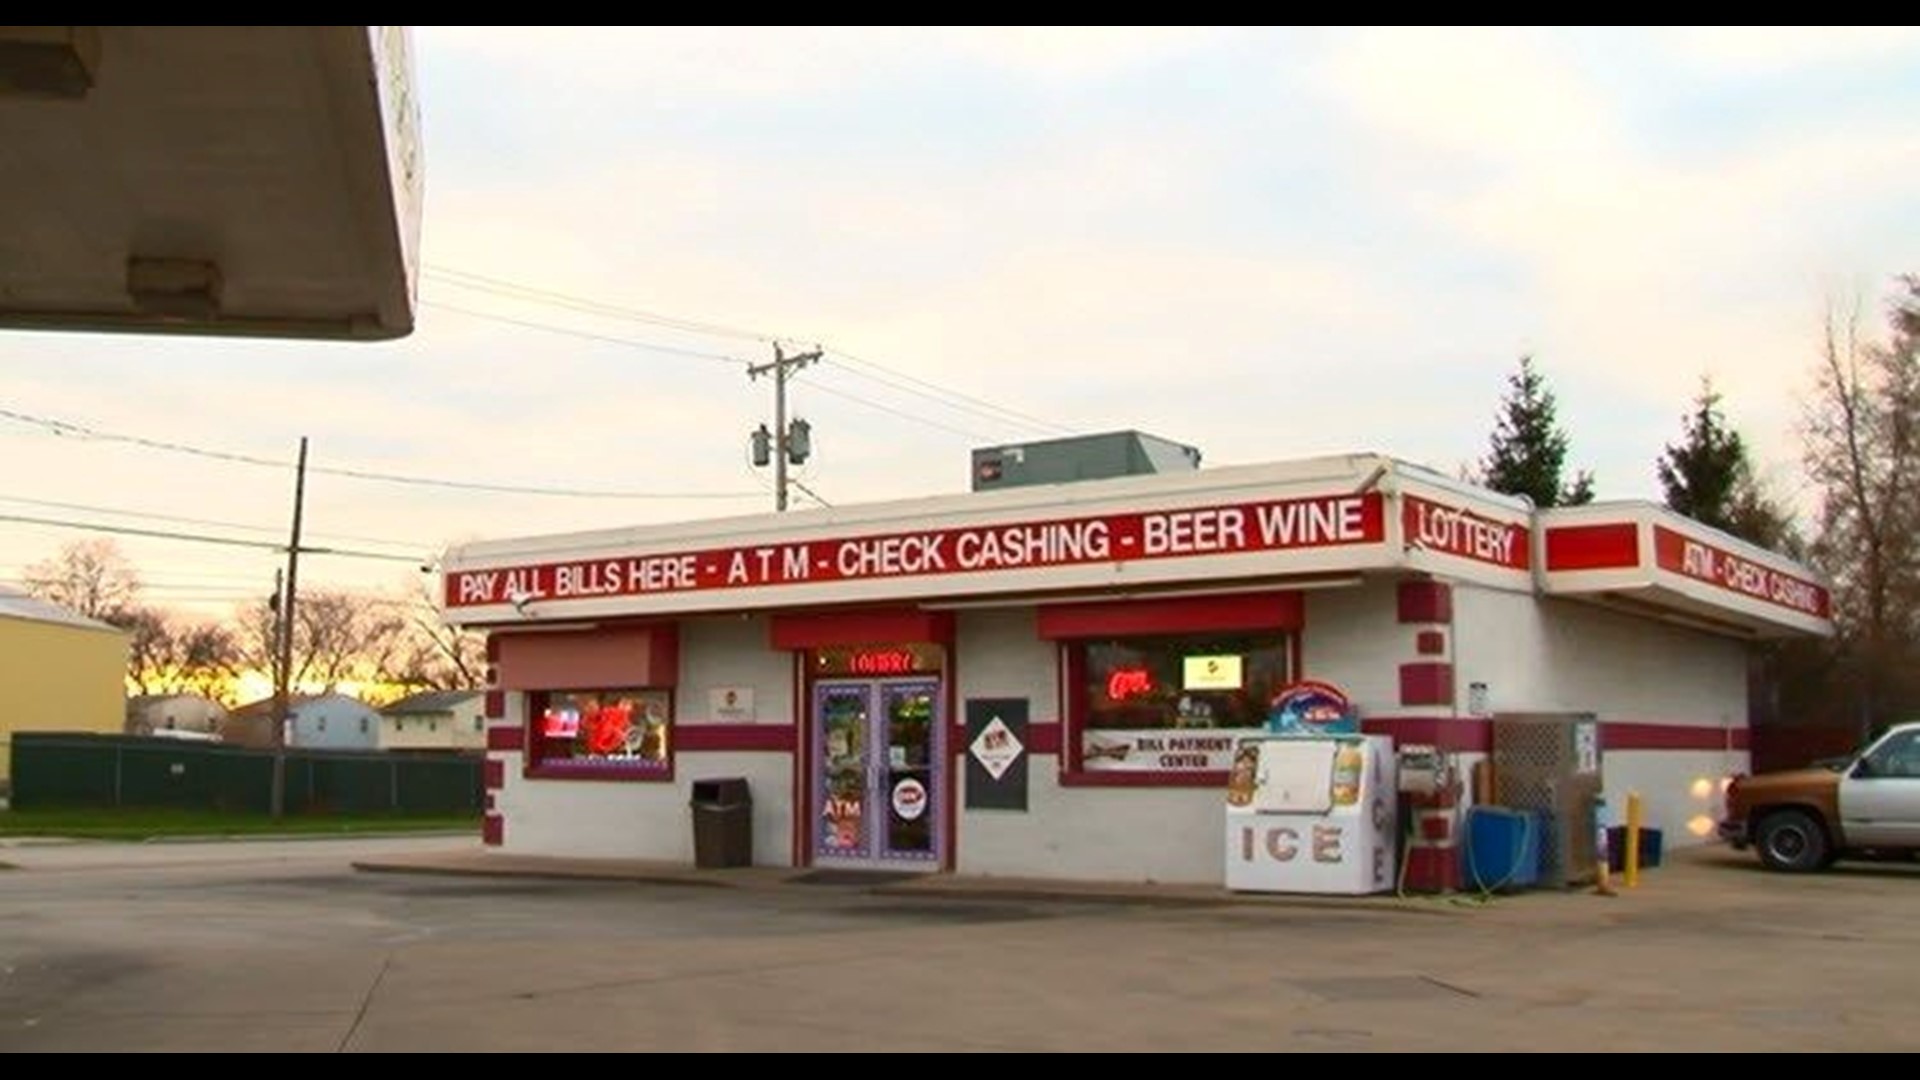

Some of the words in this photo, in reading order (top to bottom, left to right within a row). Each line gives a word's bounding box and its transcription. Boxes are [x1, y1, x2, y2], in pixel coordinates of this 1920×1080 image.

[460, 574, 494, 602] PAY
[504, 568, 546, 600] ALL
[556, 562, 621, 596] BILLS
[629, 556, 696, 591] HERE
[837, 535, 943, 576] CHECK
[957, 521, 1110, 568] CASHING
[1144, 509, 1245, 555] BEER
[1257, 500, 1364, 545] WINE
[1418, 502, 1514, 563] LOTTERY
[1683, 541, 1714, 578] ATM
[1725, 556, 1769, 598] CHECK
[1771, 572, 1818, 613] CASHING
[1137, 737, 1164, 751] BILL
[1168, 737, 1232, 751] PAYMENT
[1159, 754, 1208, 768] CENTER
[824, 800, 861, 818] ATM
[1242, 825, 1343, 863] ICE
